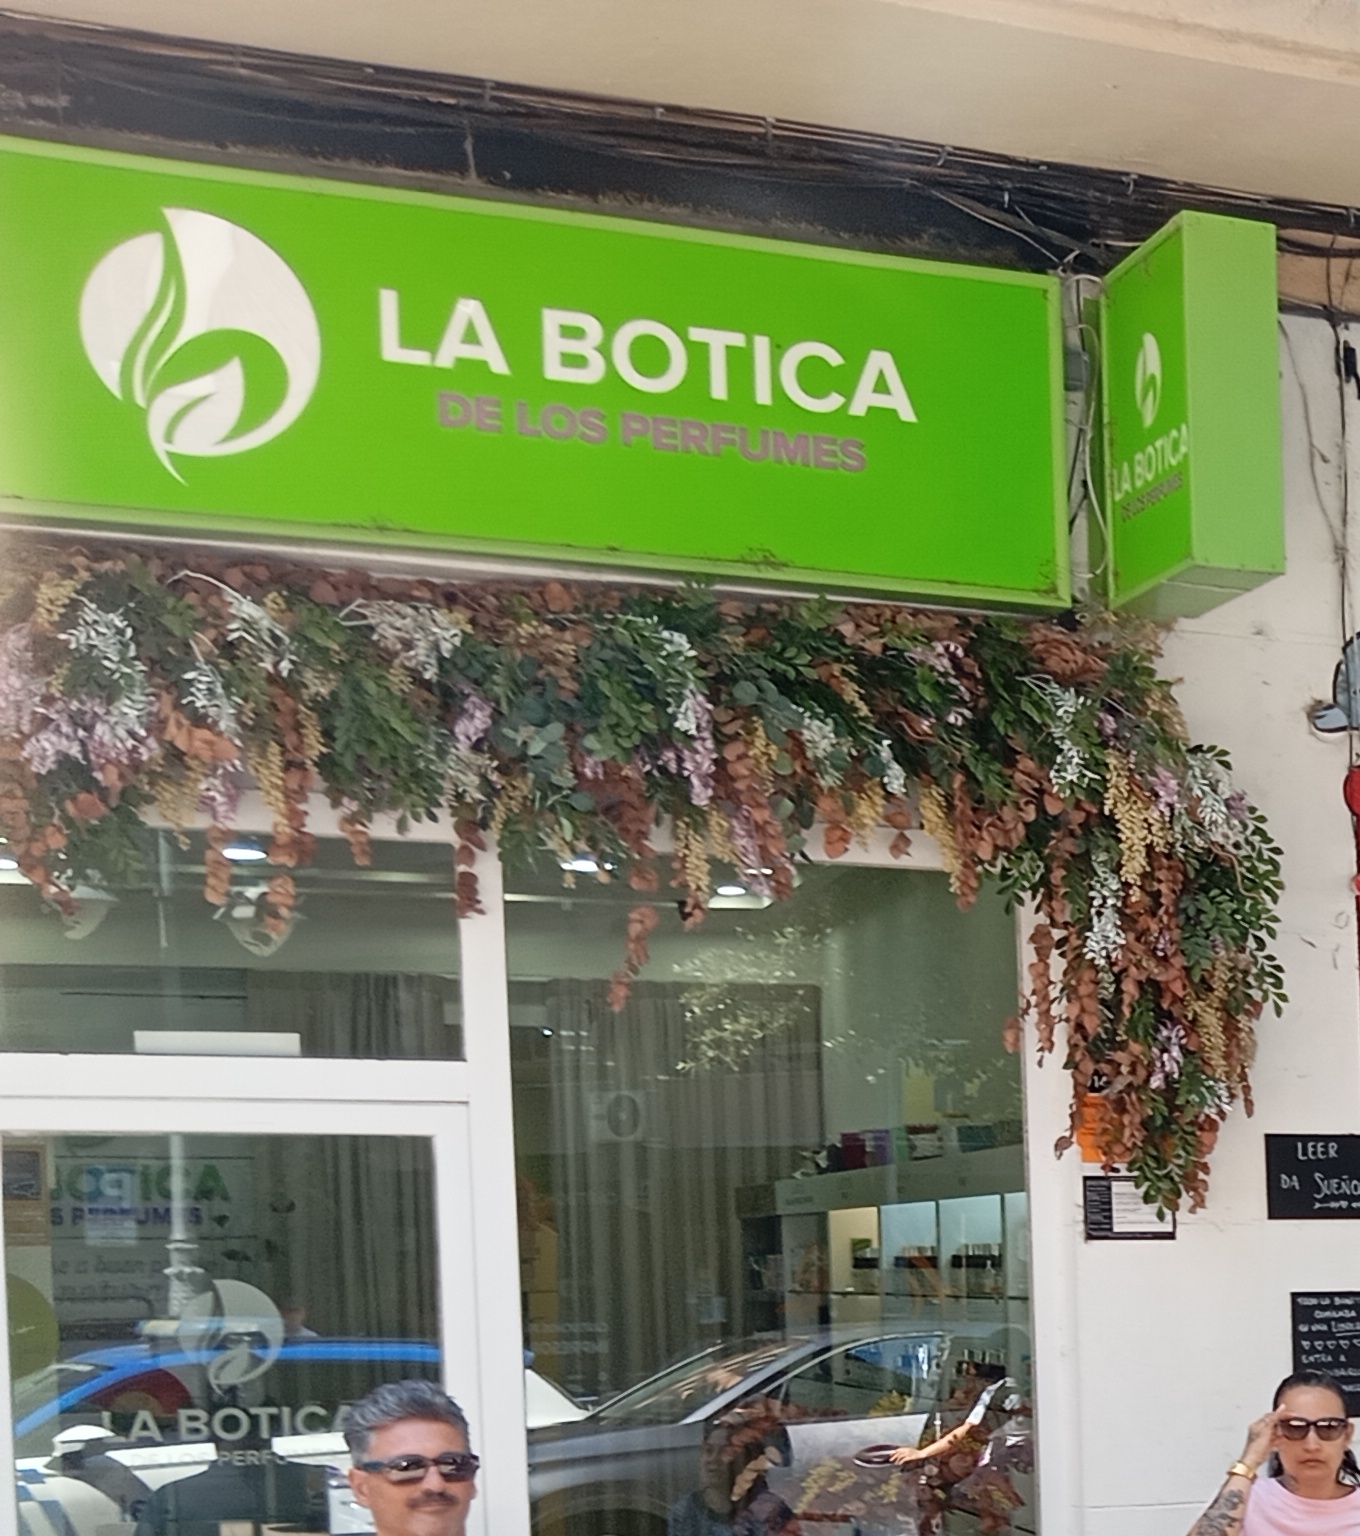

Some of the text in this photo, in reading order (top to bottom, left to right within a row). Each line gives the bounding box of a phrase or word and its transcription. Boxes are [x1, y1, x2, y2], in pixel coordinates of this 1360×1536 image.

[379, 288, 917, 423] LA BOTICA
[437, 391, 867, 473] DE LOS PERFUMES
[1113, 461, 1132, 501] LA
[1134, 423, 1188, 488] BOTICA
[1280, 1174, 1300, 1190] DA
[1297, 1142, 1338, 1160] LEER
